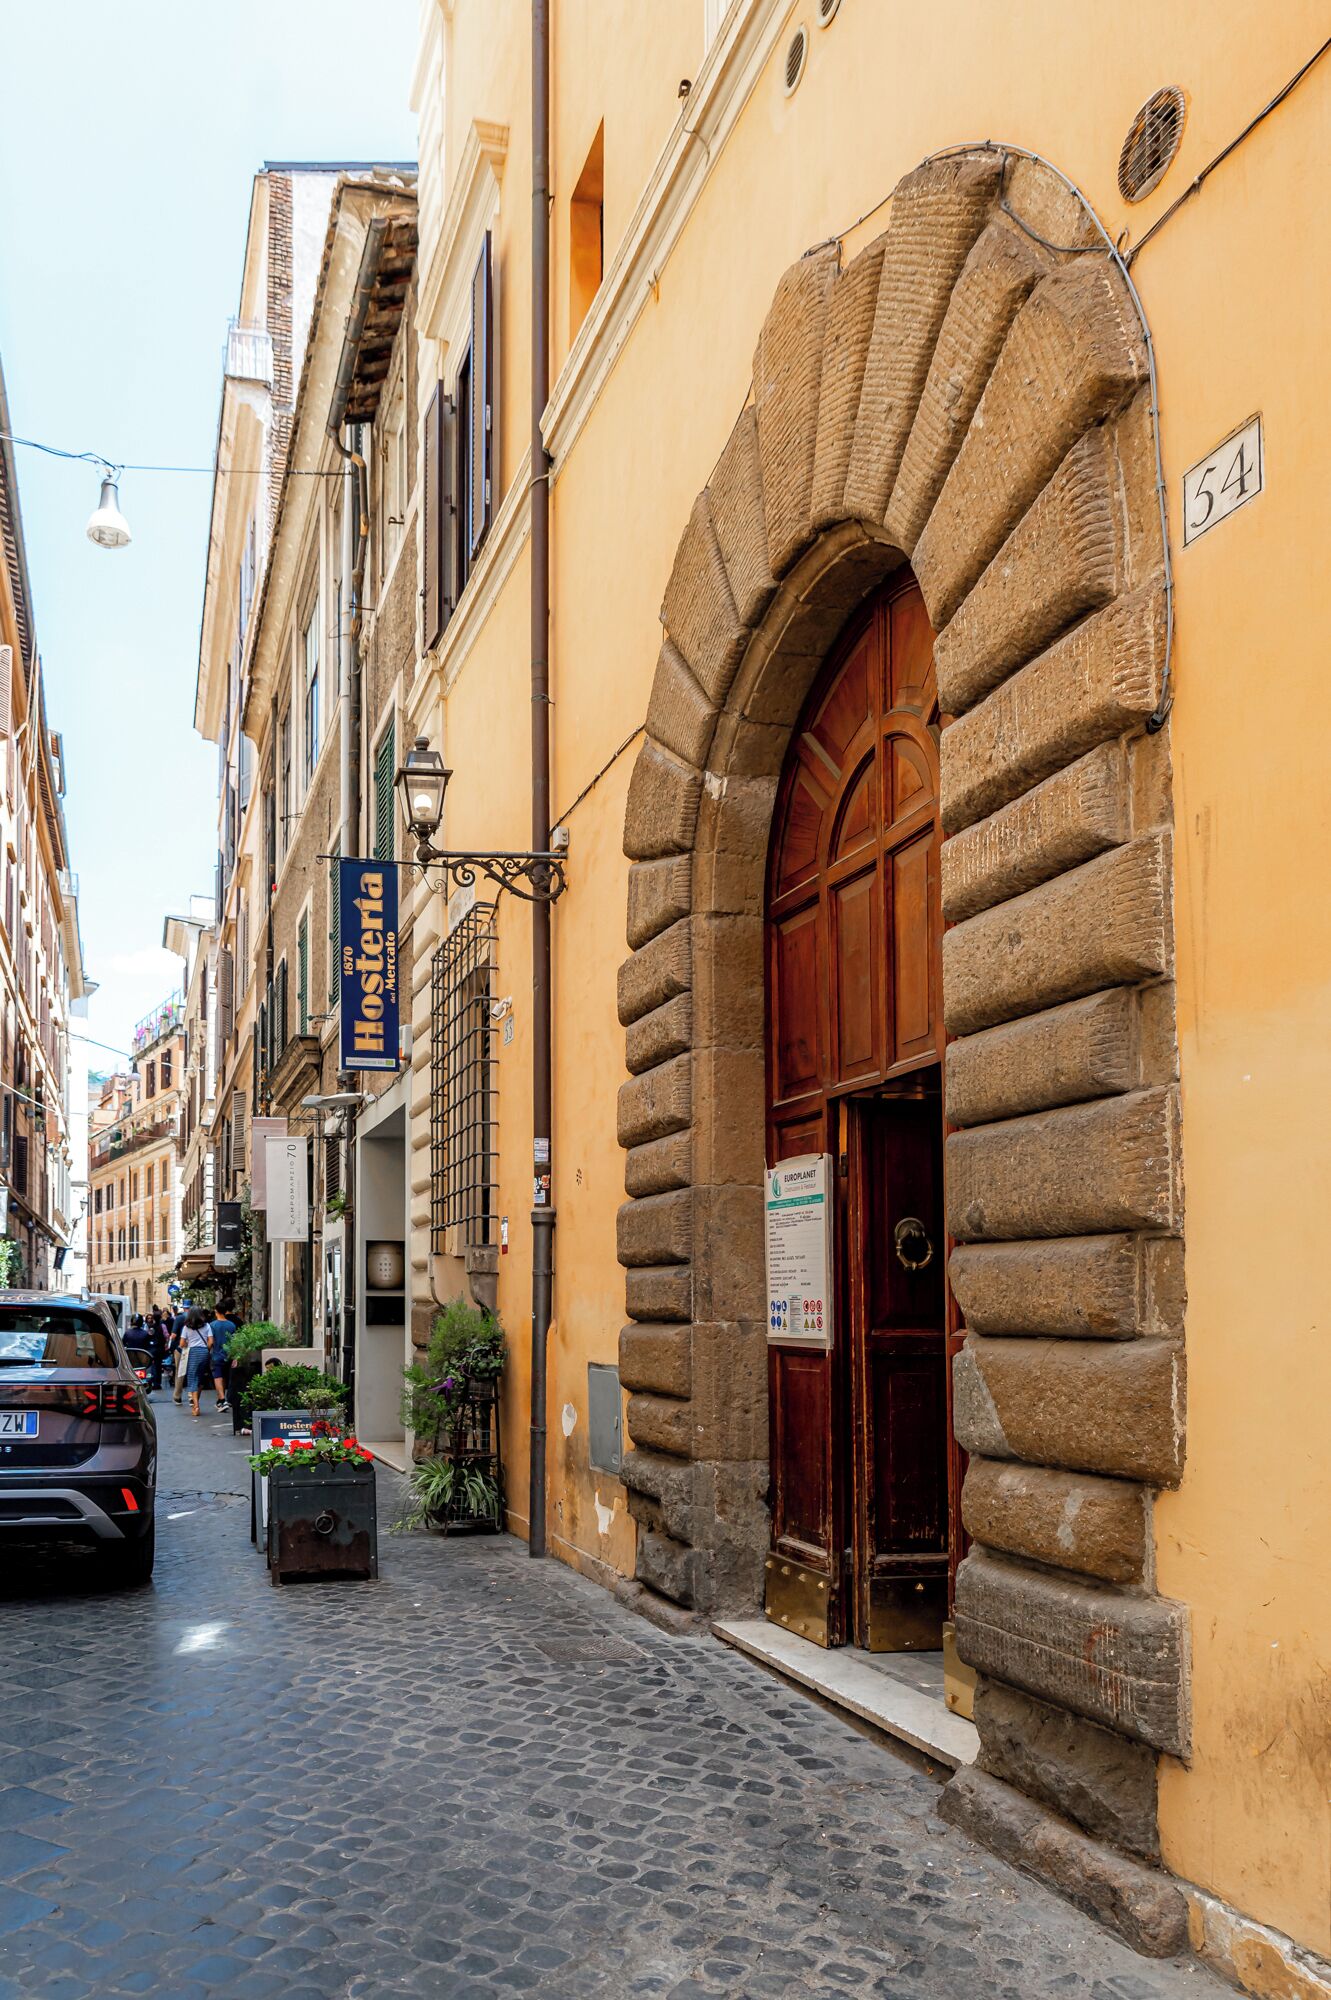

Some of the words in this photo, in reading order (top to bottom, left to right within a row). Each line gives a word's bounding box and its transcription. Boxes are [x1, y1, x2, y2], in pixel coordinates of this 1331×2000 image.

[1190, 442, 1254, 529] 54
[343, 946, 354, 976] 1870
[385, 931, 396, 991] Mercato
[286, 1144, 297, 1158] 70
[784, 1169, 816, 1183] EUROPLANET
[0, 1414, 24, 1432] ZW
